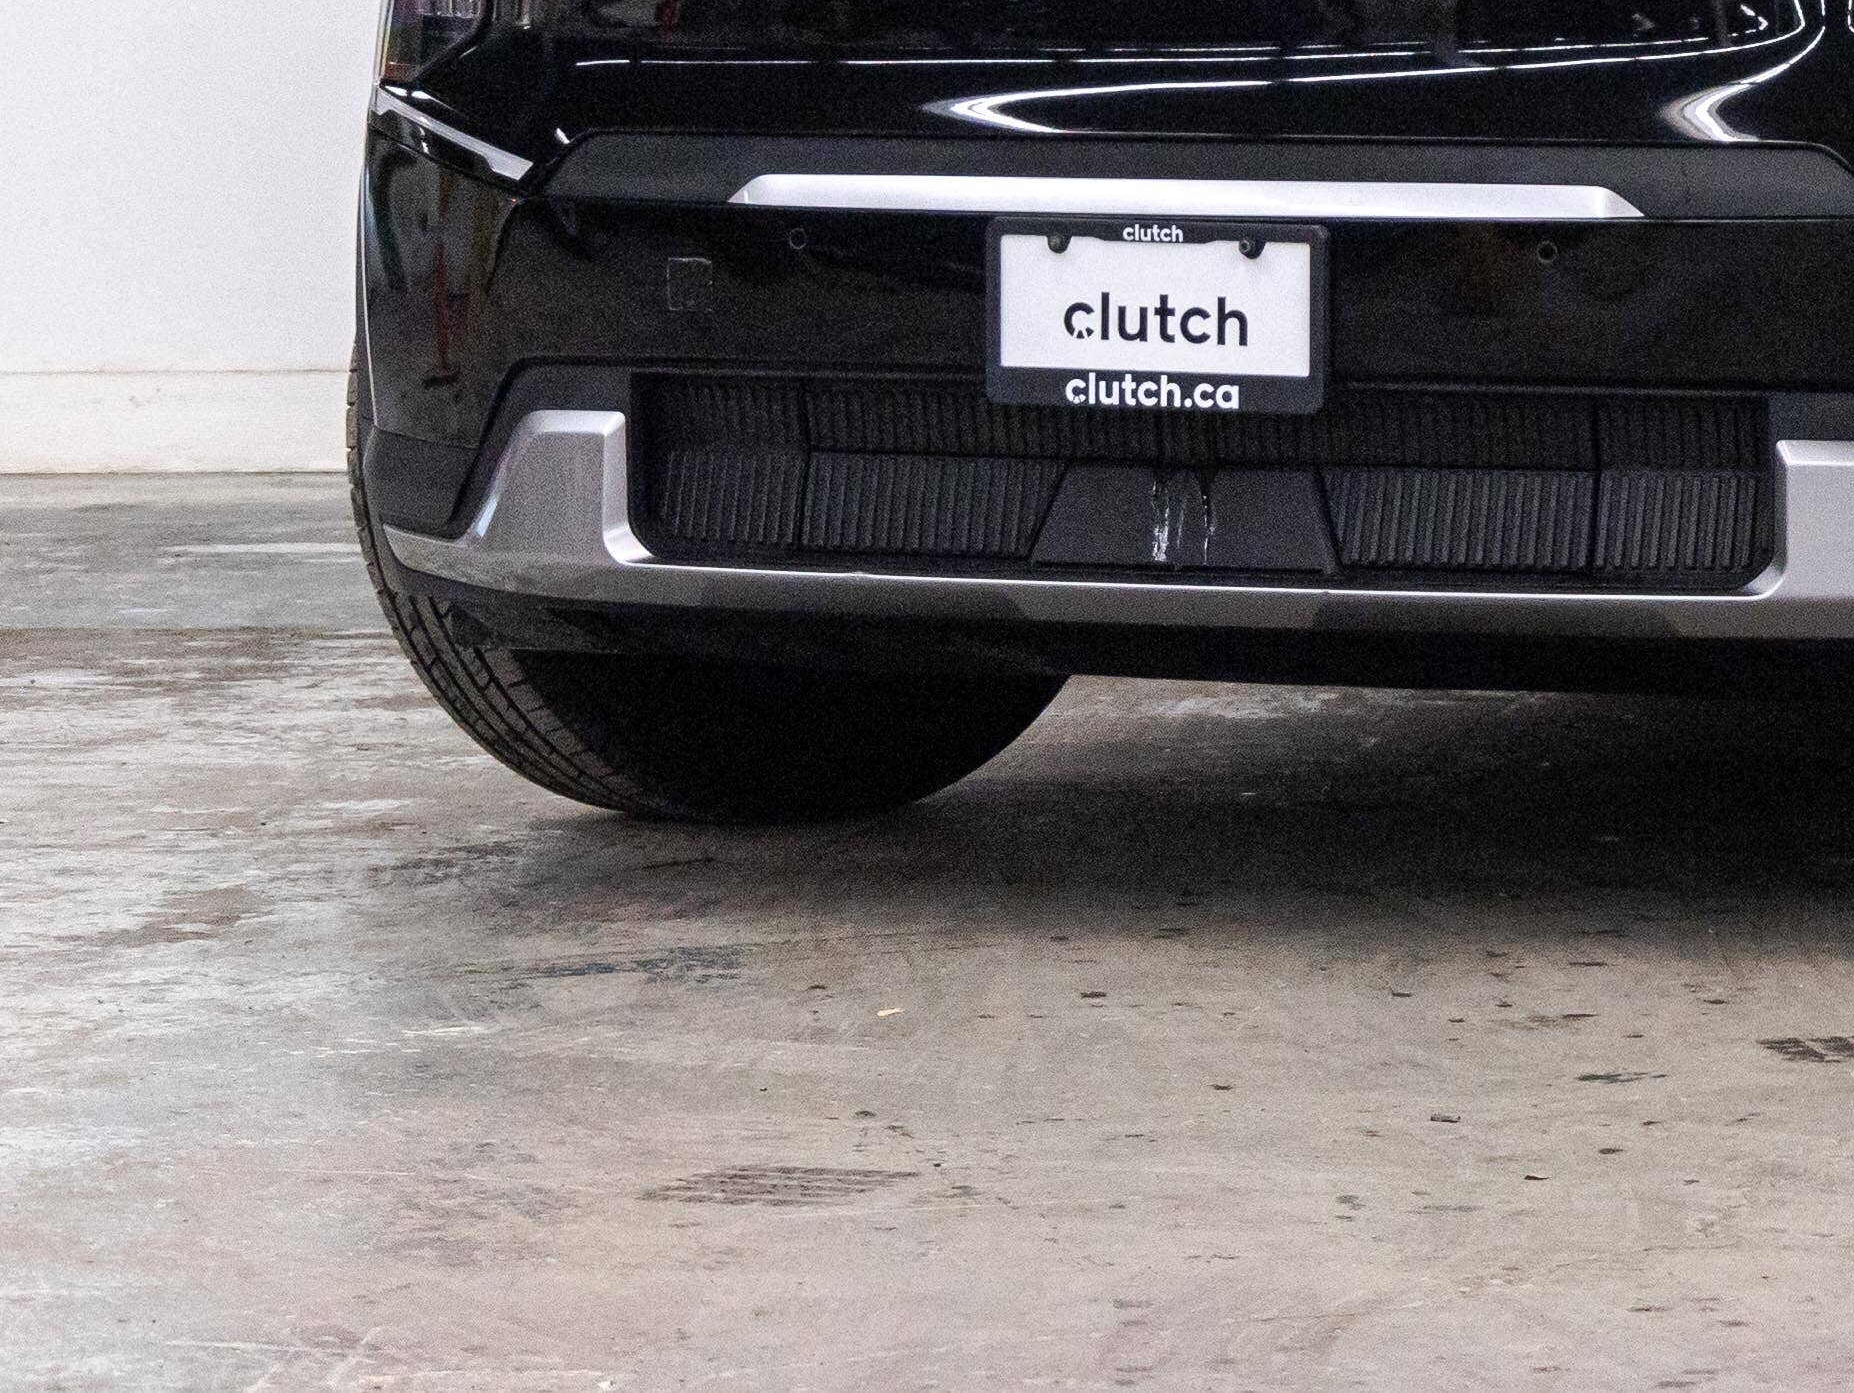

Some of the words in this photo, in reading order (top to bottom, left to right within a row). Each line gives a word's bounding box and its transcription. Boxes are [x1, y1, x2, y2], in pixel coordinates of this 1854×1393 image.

[1122, 224, 1184, 243] clutch
[1064, 292, 1248, 346] clutch
[1065, 373, 1240, 409] clutch.ca
